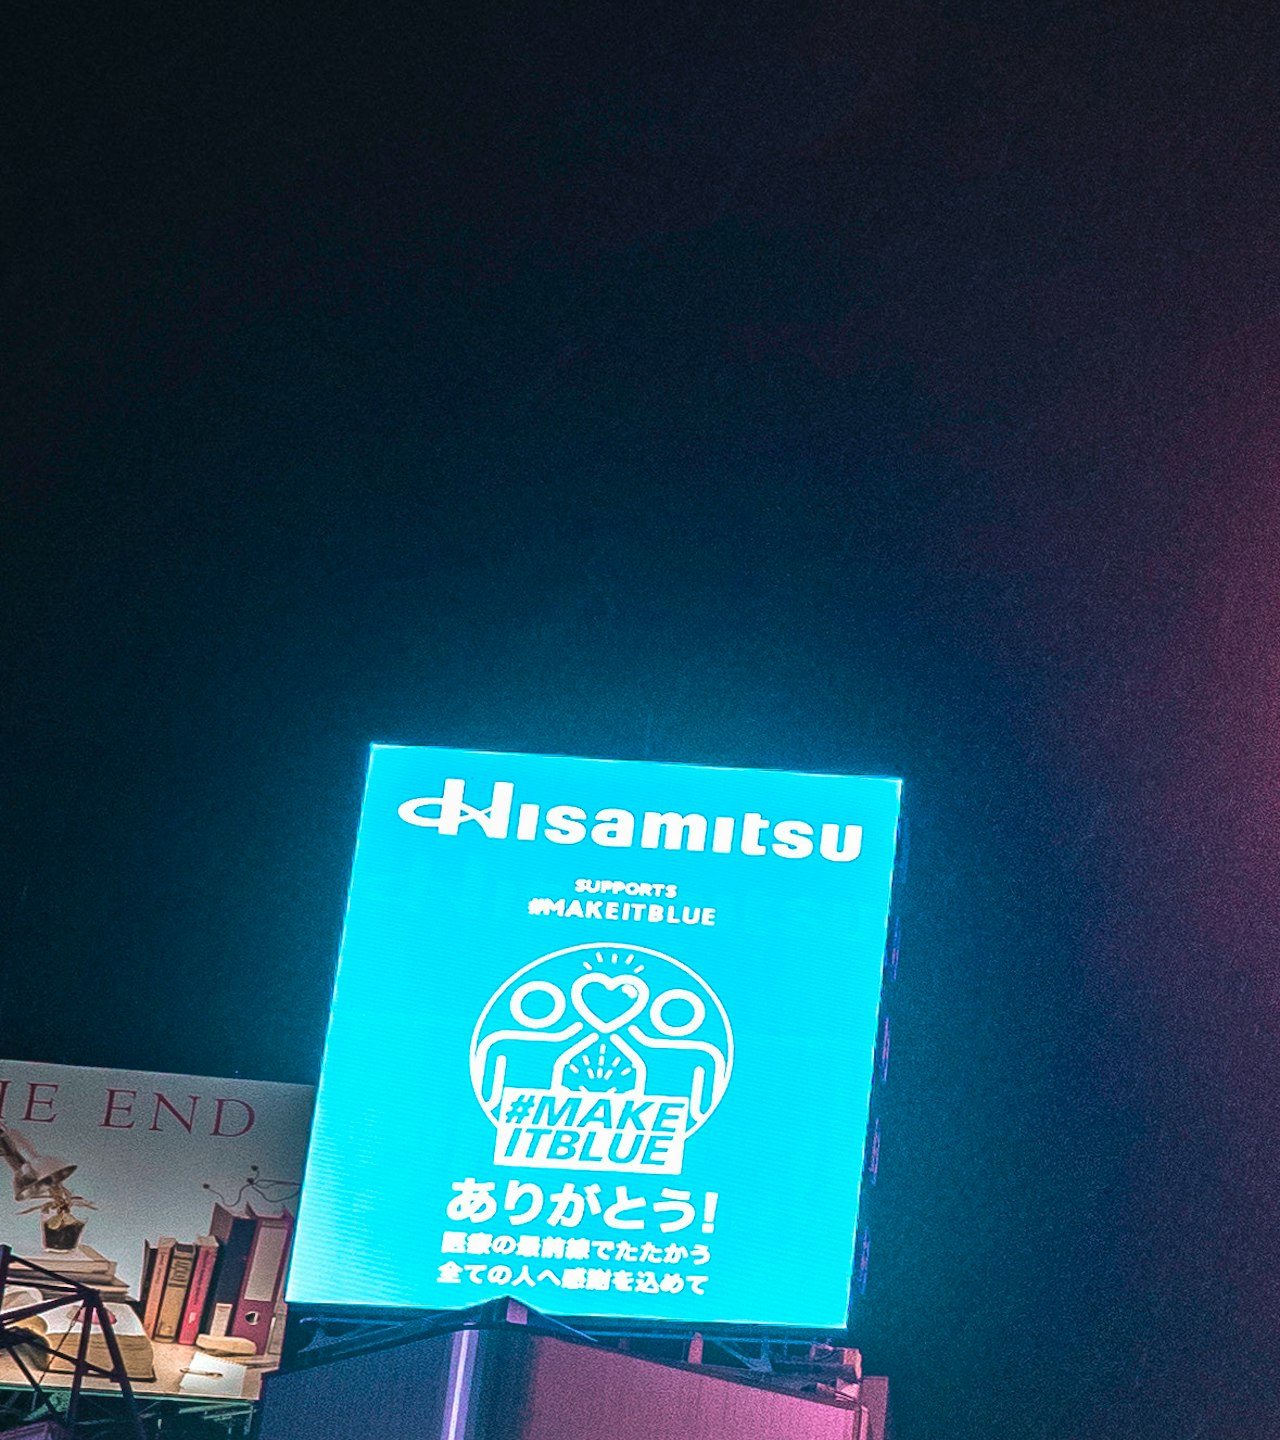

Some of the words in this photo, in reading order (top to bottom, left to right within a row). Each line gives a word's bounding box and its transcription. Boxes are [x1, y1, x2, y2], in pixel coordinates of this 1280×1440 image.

[398, 778, 864, 864] Hisamitsu
[574, 877, 678, 900] SUPPORTS
[527, 897, 718, 928] #MAKEITBLUE
[99, 1088, 257, 1138] END
[504, 1094, 686, 1133] #MAKE
[504, 1127, 676, 1166] ITBLUE
[436, 1260, 710, 1296] 全ての人へ感謝を込めて
